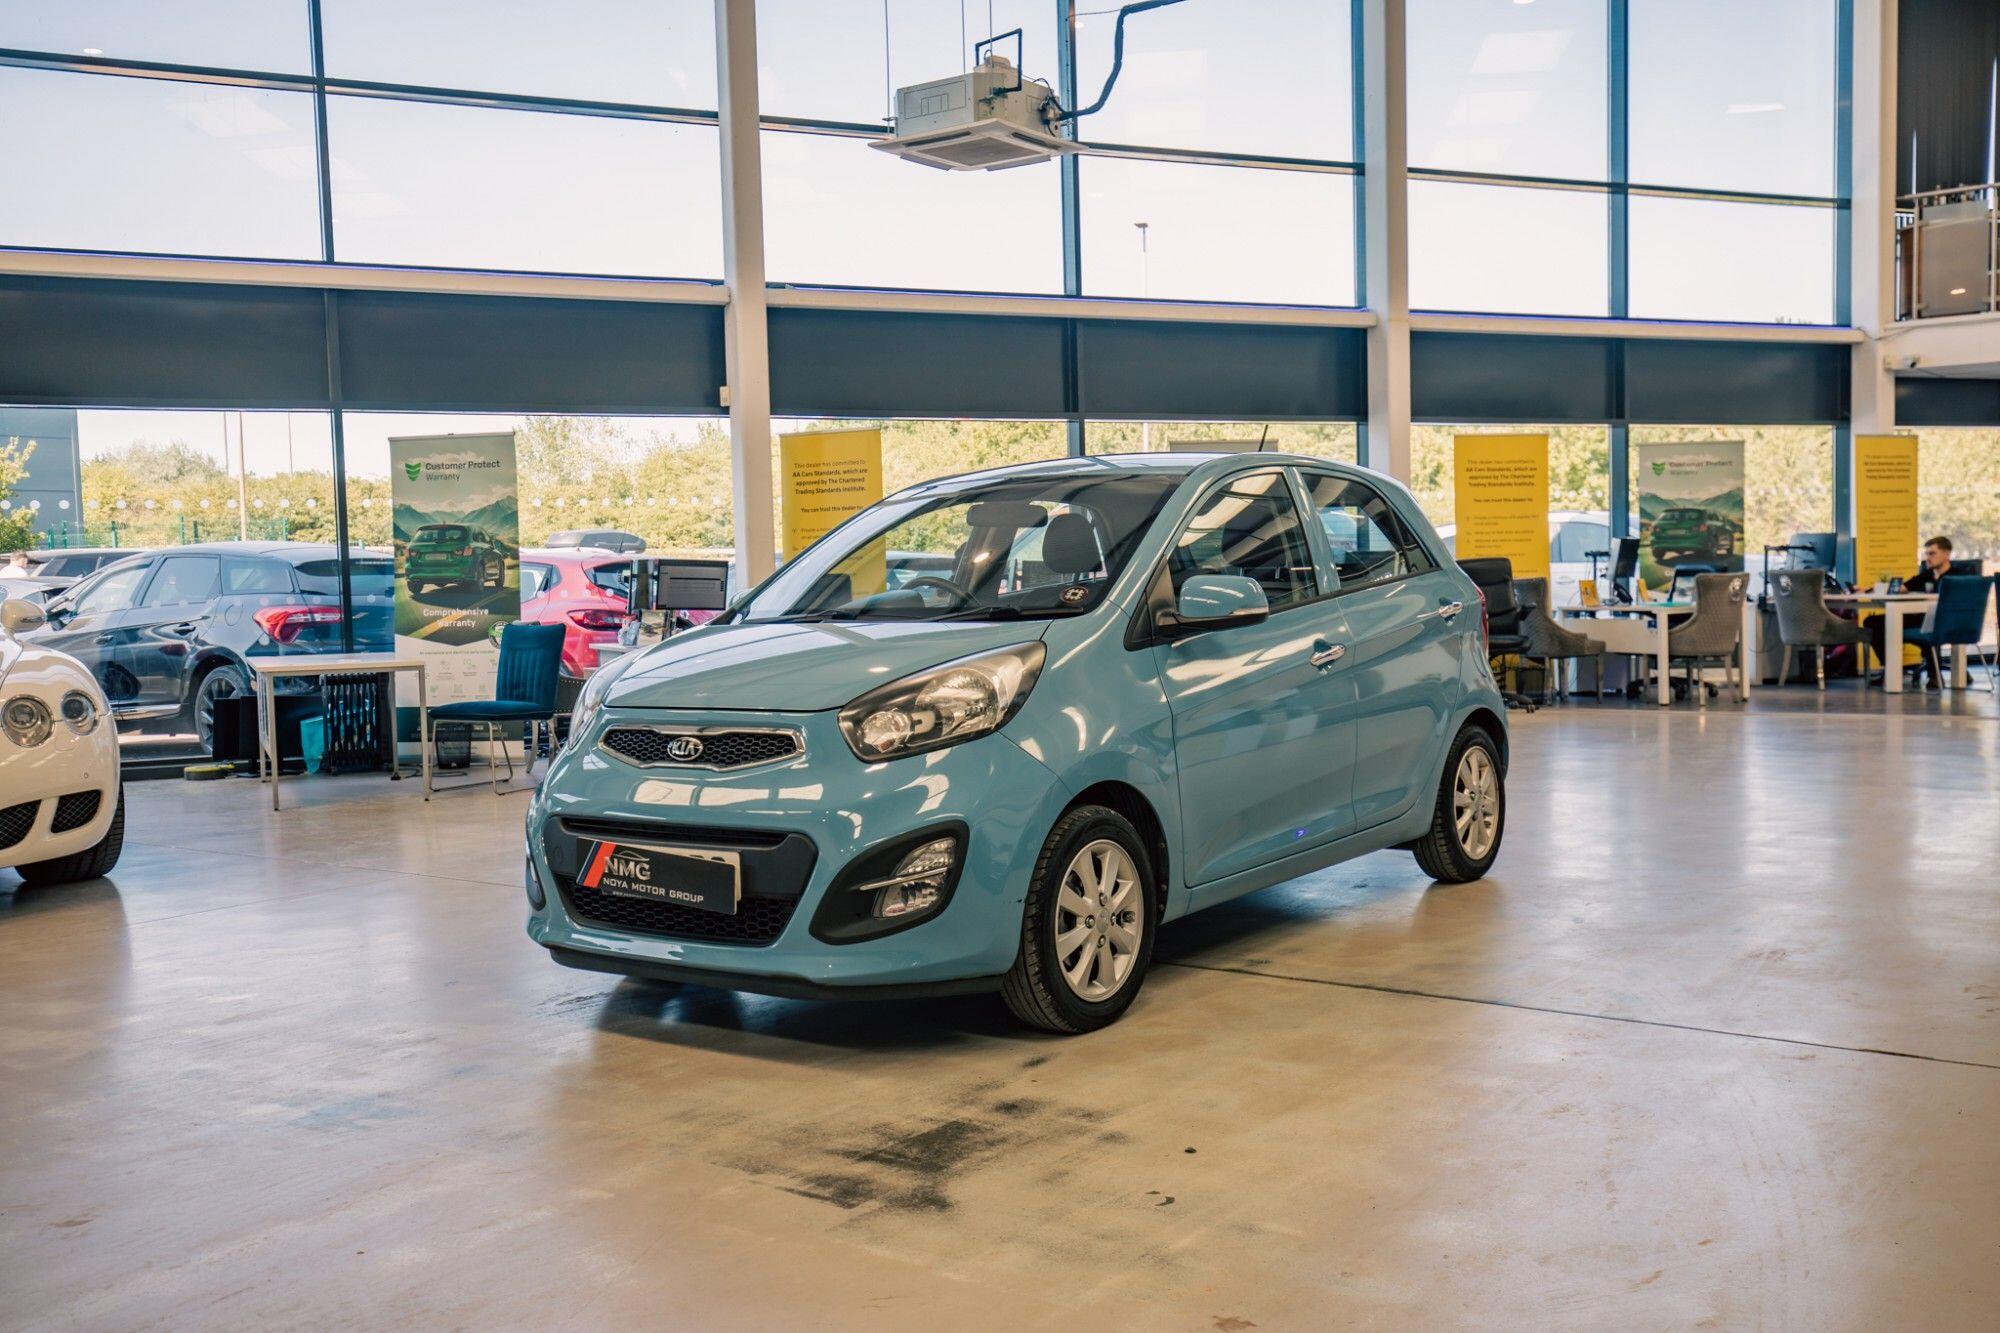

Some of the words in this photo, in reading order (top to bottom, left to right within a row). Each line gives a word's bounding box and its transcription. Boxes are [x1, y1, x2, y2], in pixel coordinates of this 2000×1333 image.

[425, 462, 466, 471] Customer
[468, 460, 501, 469] Protect
[425, 473, 460, 481] Warranty
[423, 608, 489, 616] Comprehensive
[437, 620, 476, 629] Warranty
[672, 741, 696, 755] KIA
[604, 857, 650, 881] NMG
[603, 877, 628, 889] NOYA
[631, 882, 666, 896] MOTOR
[669, 889, 704, 902] GROUP
